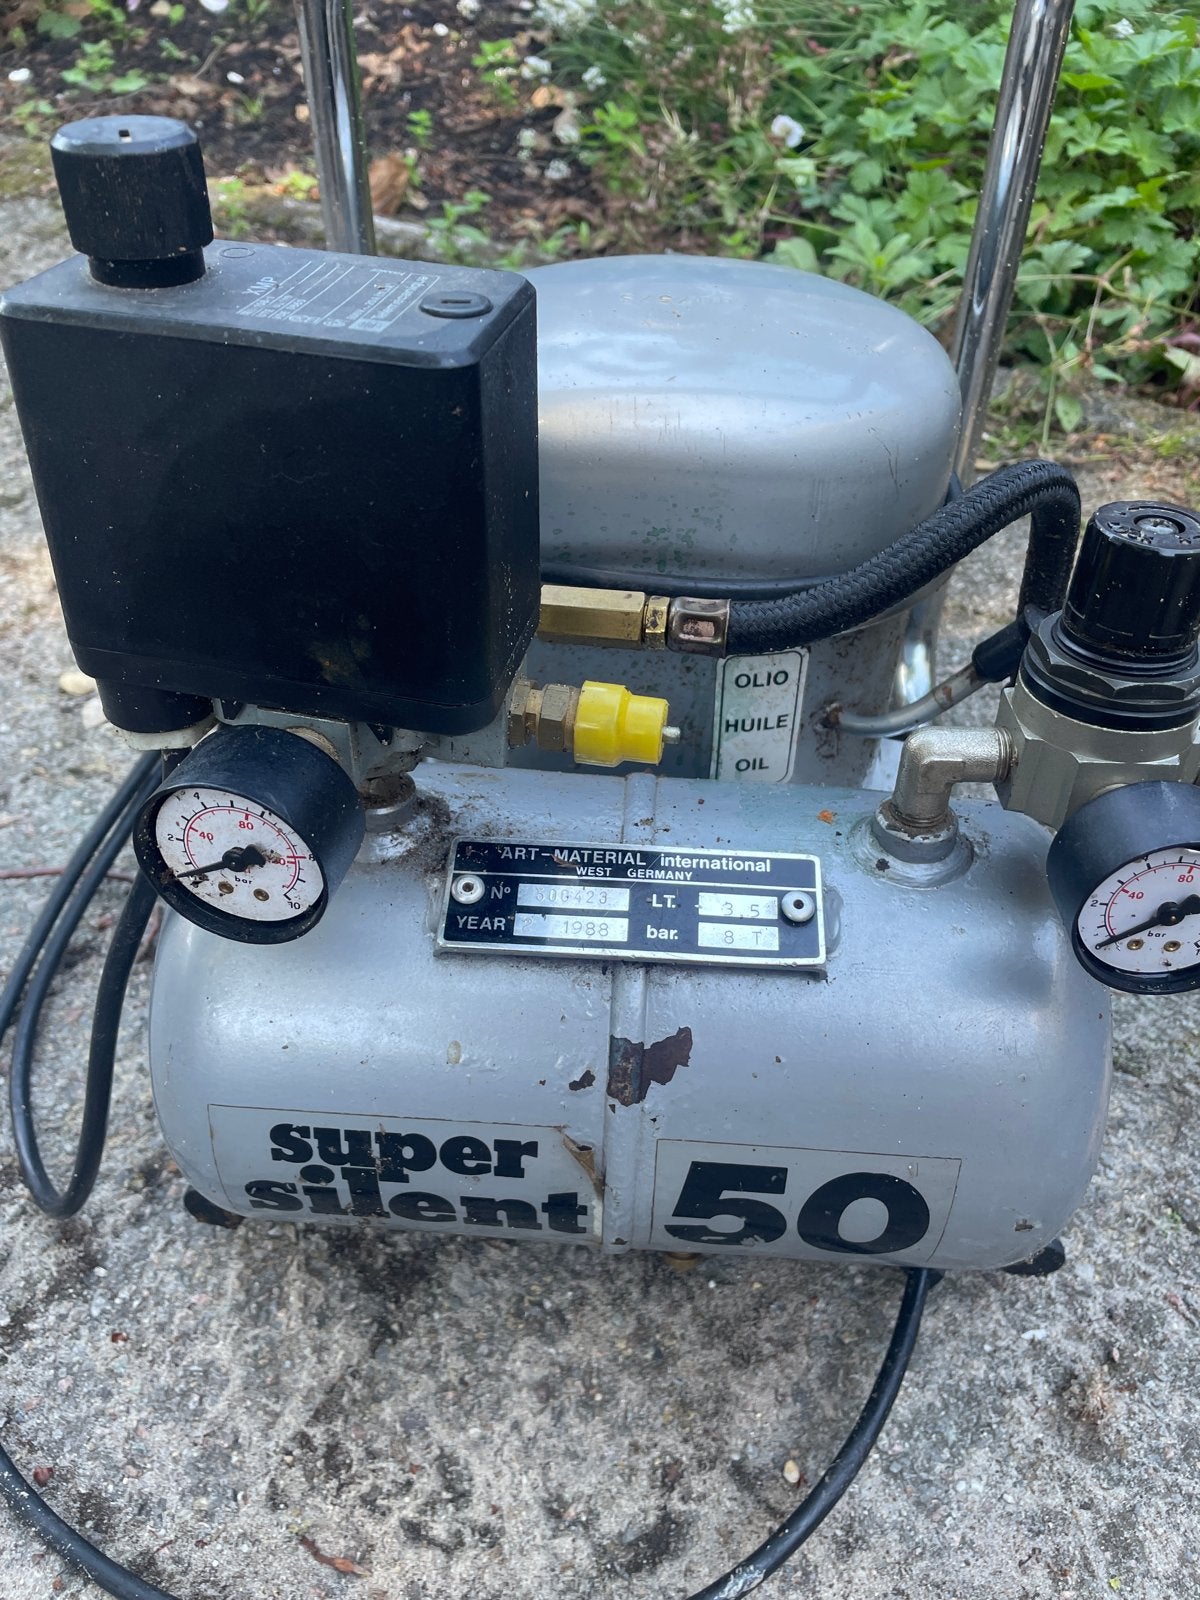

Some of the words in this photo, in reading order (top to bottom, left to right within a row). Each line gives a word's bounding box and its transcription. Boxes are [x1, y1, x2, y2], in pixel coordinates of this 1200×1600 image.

[735, 670, 789, 688] OLIO
[725, 714, 789, 733] HUILE
[735, 757, 769, 772] OIL
[193, 791, 200, 800] 4
[239, 821, 254, 830] 80
[167, 833, 175, 842] 2
[199, 831, 214, 841] 40
[660, 853, 771, 873] international
[576, 866, 612, 877] WEST
[627, 868, 694, 881] GERMANY
[1177, 874, 1194, 883] 80
[235, 875, 253, 885] bar
[1127, 891, 1145, 900] 40
[287, 901, 301, 910] 10
[1090, 899, 1098, 908] 2
[456, 915, 506, 931] YEAR
[563, 920, 610, 937] 1988
[646, 924, 679, 940] bar.
[723, 930, 735, 945] 8
[752, 931, 763, 945] T
[1147, 930, 1167, 938] bar
[270, 1123, 539, 1184] super
[244, 1164, 589, 1234] silent
[663, 1161, 931, 1255] 50
